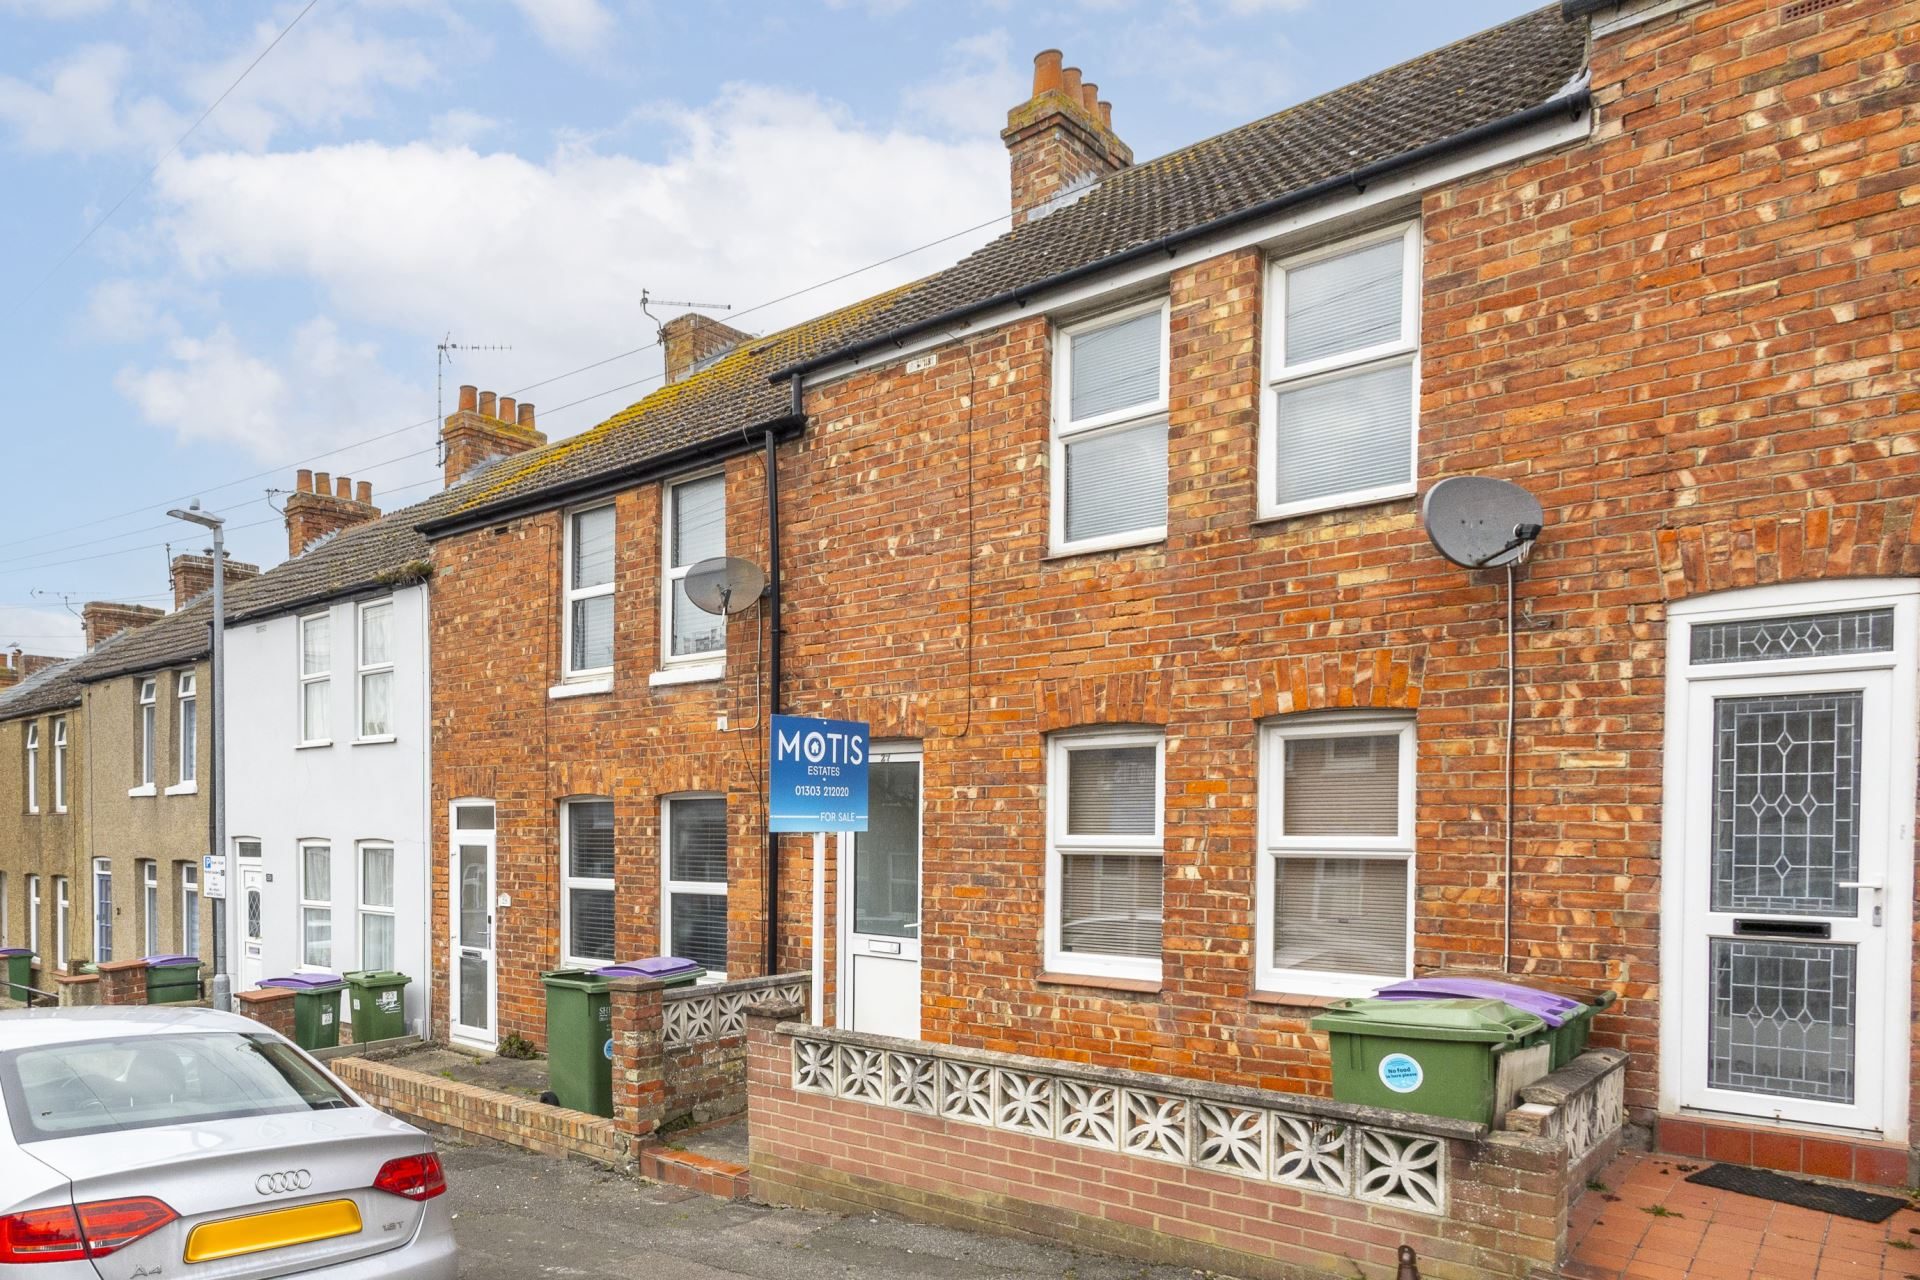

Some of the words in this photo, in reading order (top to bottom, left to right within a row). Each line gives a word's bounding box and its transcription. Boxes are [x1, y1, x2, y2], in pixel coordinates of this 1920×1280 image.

[778, 729, 863, 765] MOTIS
[807, 765, 840, 776] ESTATES
[795, 785, 821, 796] 01303
[823, 786, 849, 797] 212020
[820, 811, 836, 822] FOR
[838, 811, 856, 822] SALE
[385, 991, 395, 1000] 23
